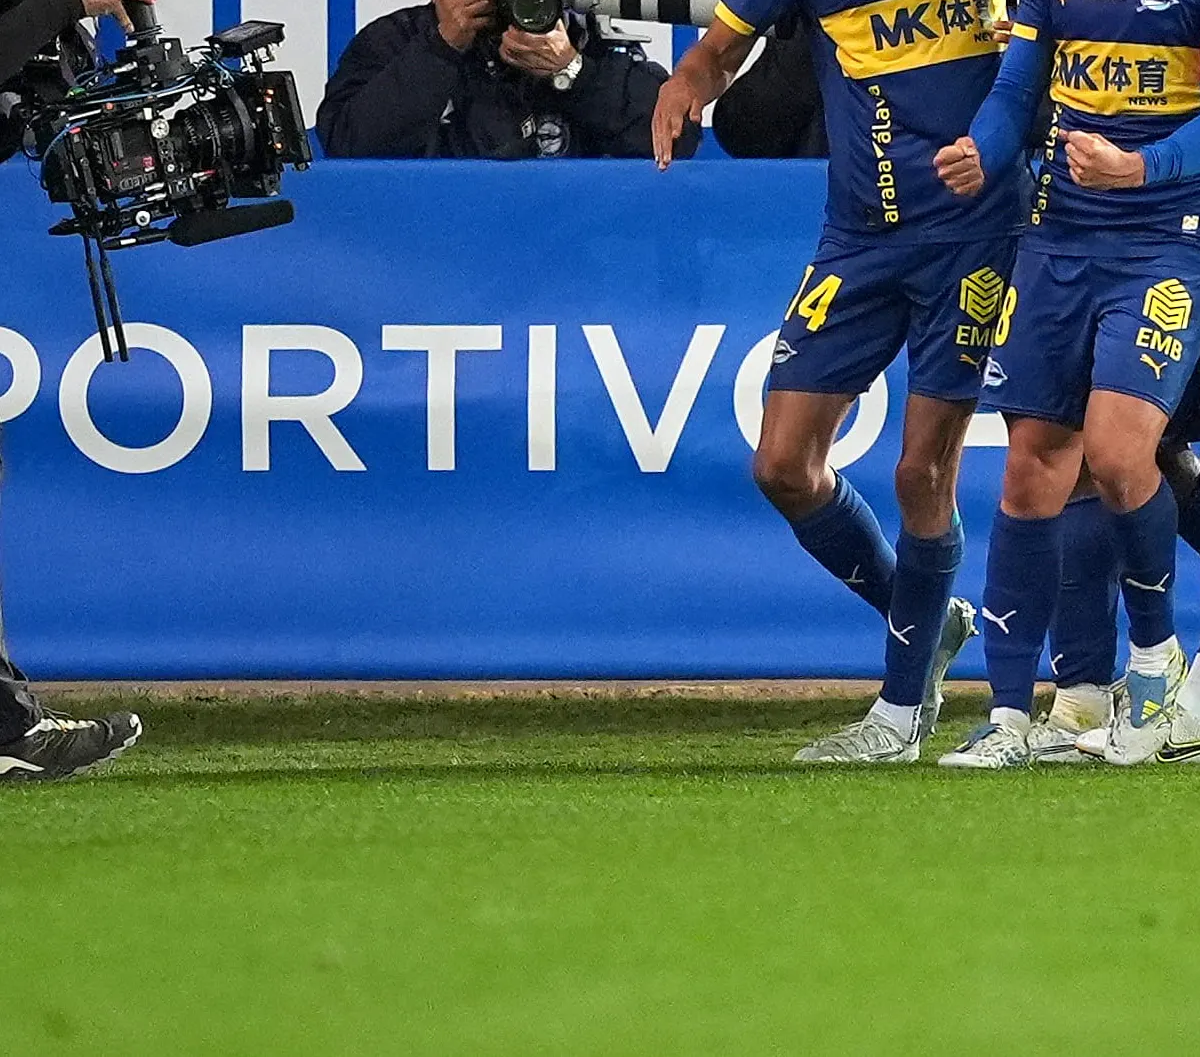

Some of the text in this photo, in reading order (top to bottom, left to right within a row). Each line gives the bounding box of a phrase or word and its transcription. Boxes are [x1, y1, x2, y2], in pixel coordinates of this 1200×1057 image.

[1128, 96, 1168, 106] NEWS
[877, 159, 899, 223] araba
[955, 323, 995, 347] EM
[1135, 326, 1183, 362] EMB
